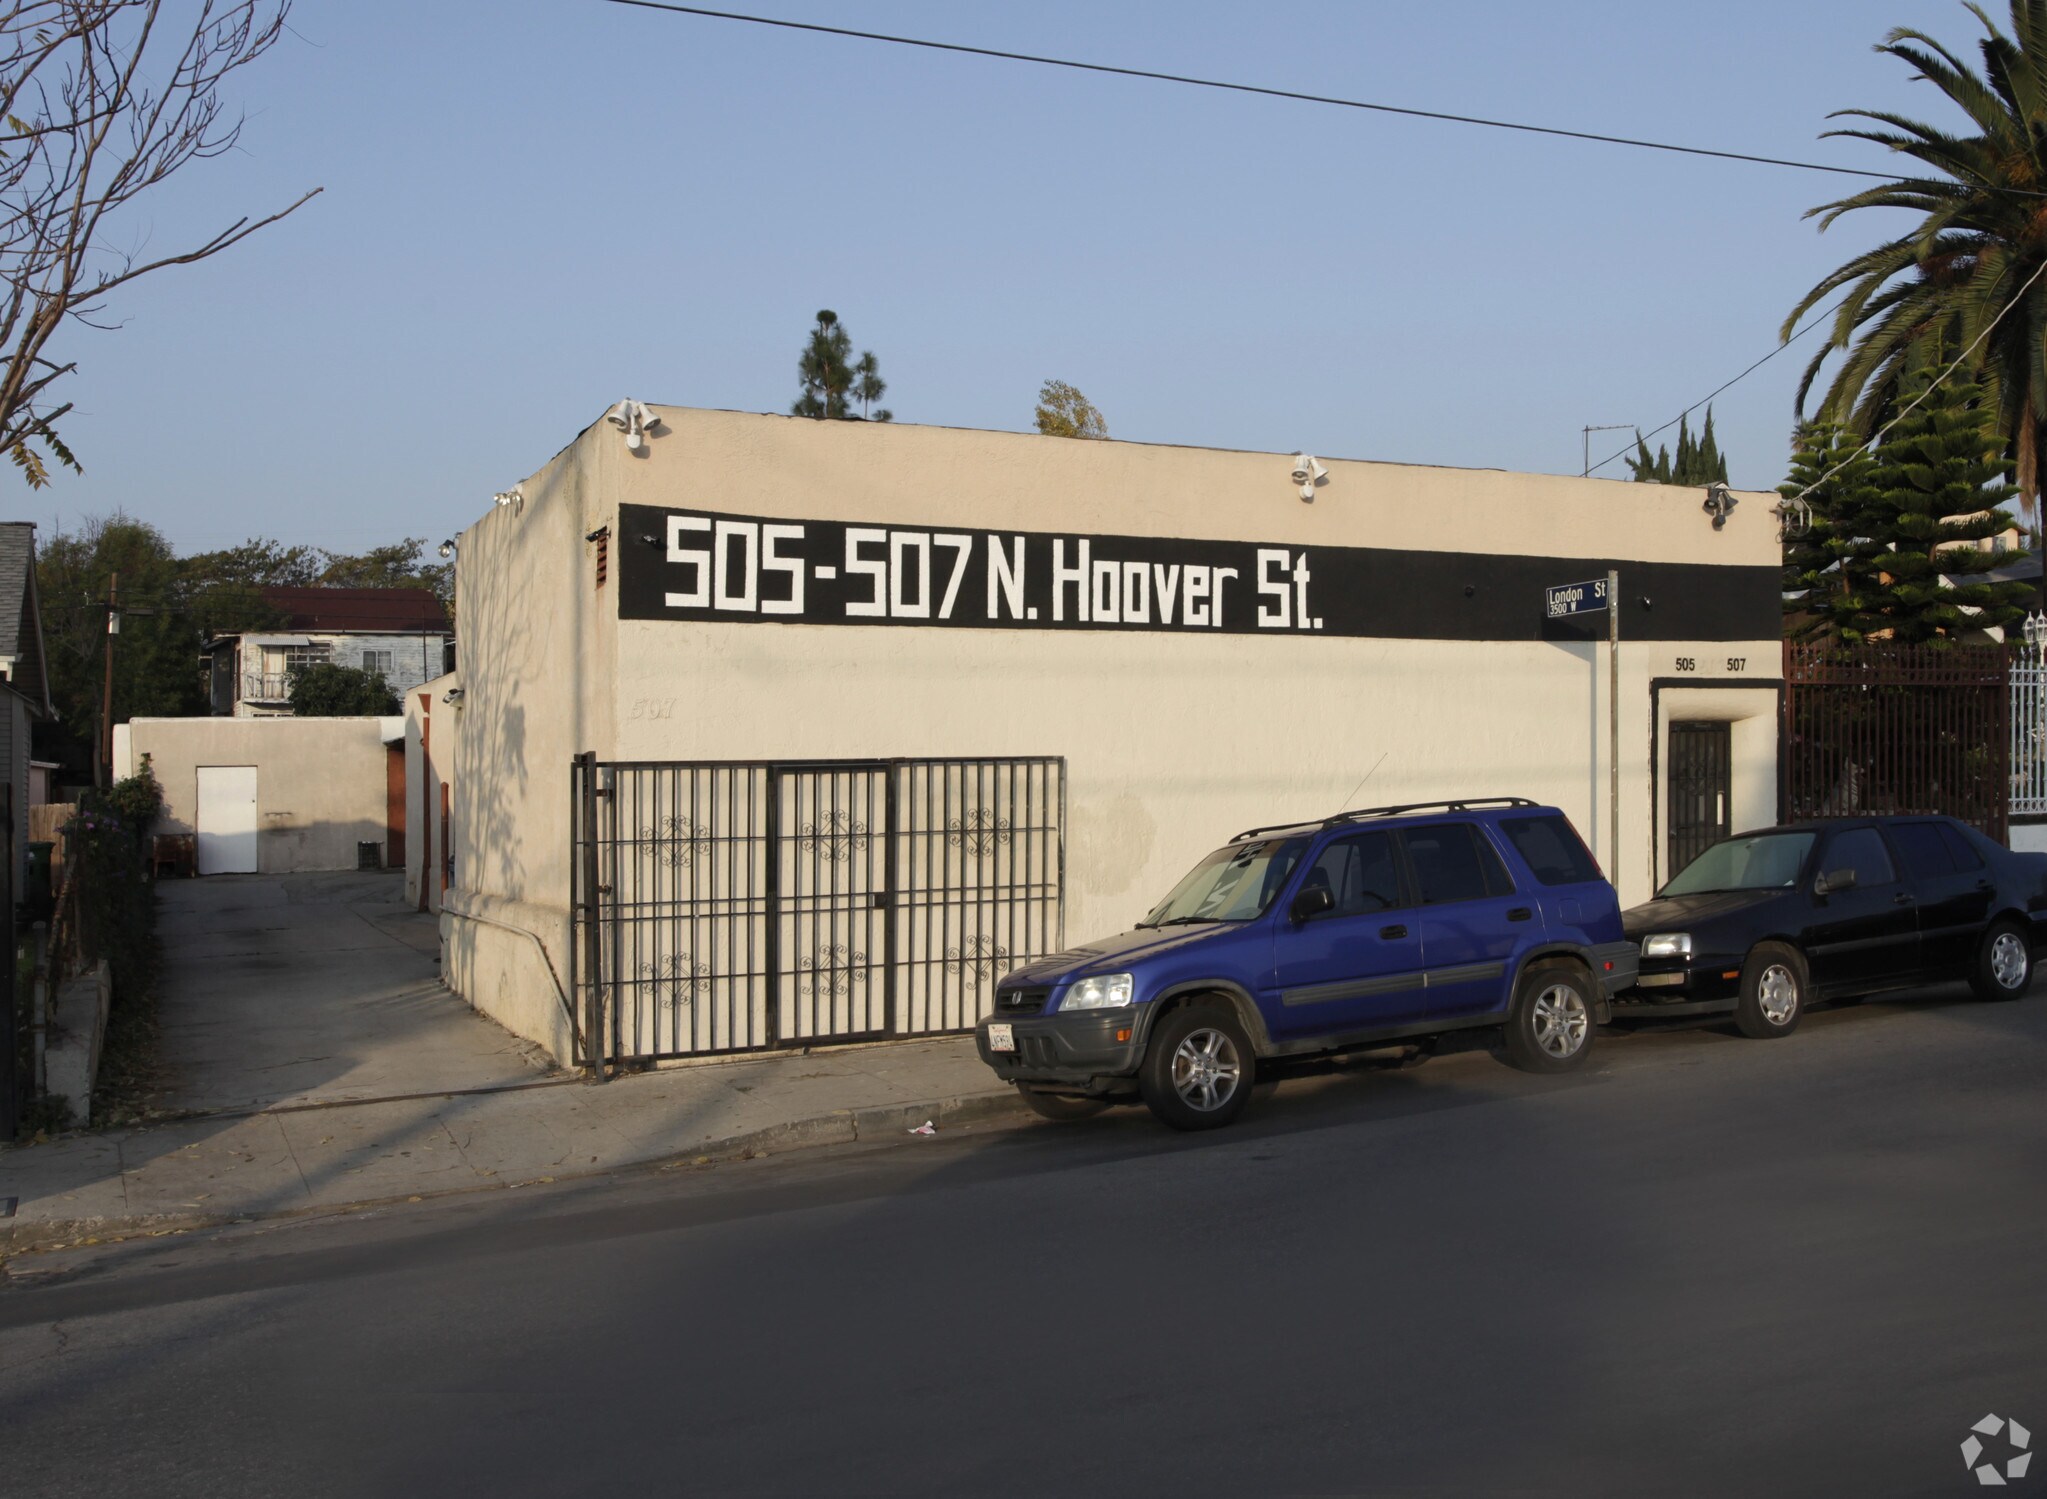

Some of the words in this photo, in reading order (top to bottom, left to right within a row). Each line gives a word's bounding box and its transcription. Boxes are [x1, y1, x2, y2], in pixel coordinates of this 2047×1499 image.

[664, 515, 973, 619] 505-507
[987, 535, 1038, 620] N.
[1052, 539, 1239, 628] Hoover
[1257, 548, 1323, 629] St.
[1549, 588, 1583, 605] London
[1594, 581, 1606, 598] St
[1550, 602, 1567, 615] 3500
[1570, 601, 1577, 612] W
[1675, 657, 1695, 672] 505
[1726, 657, 1746, 672] 507
[630, 697, 677, 720] 507
